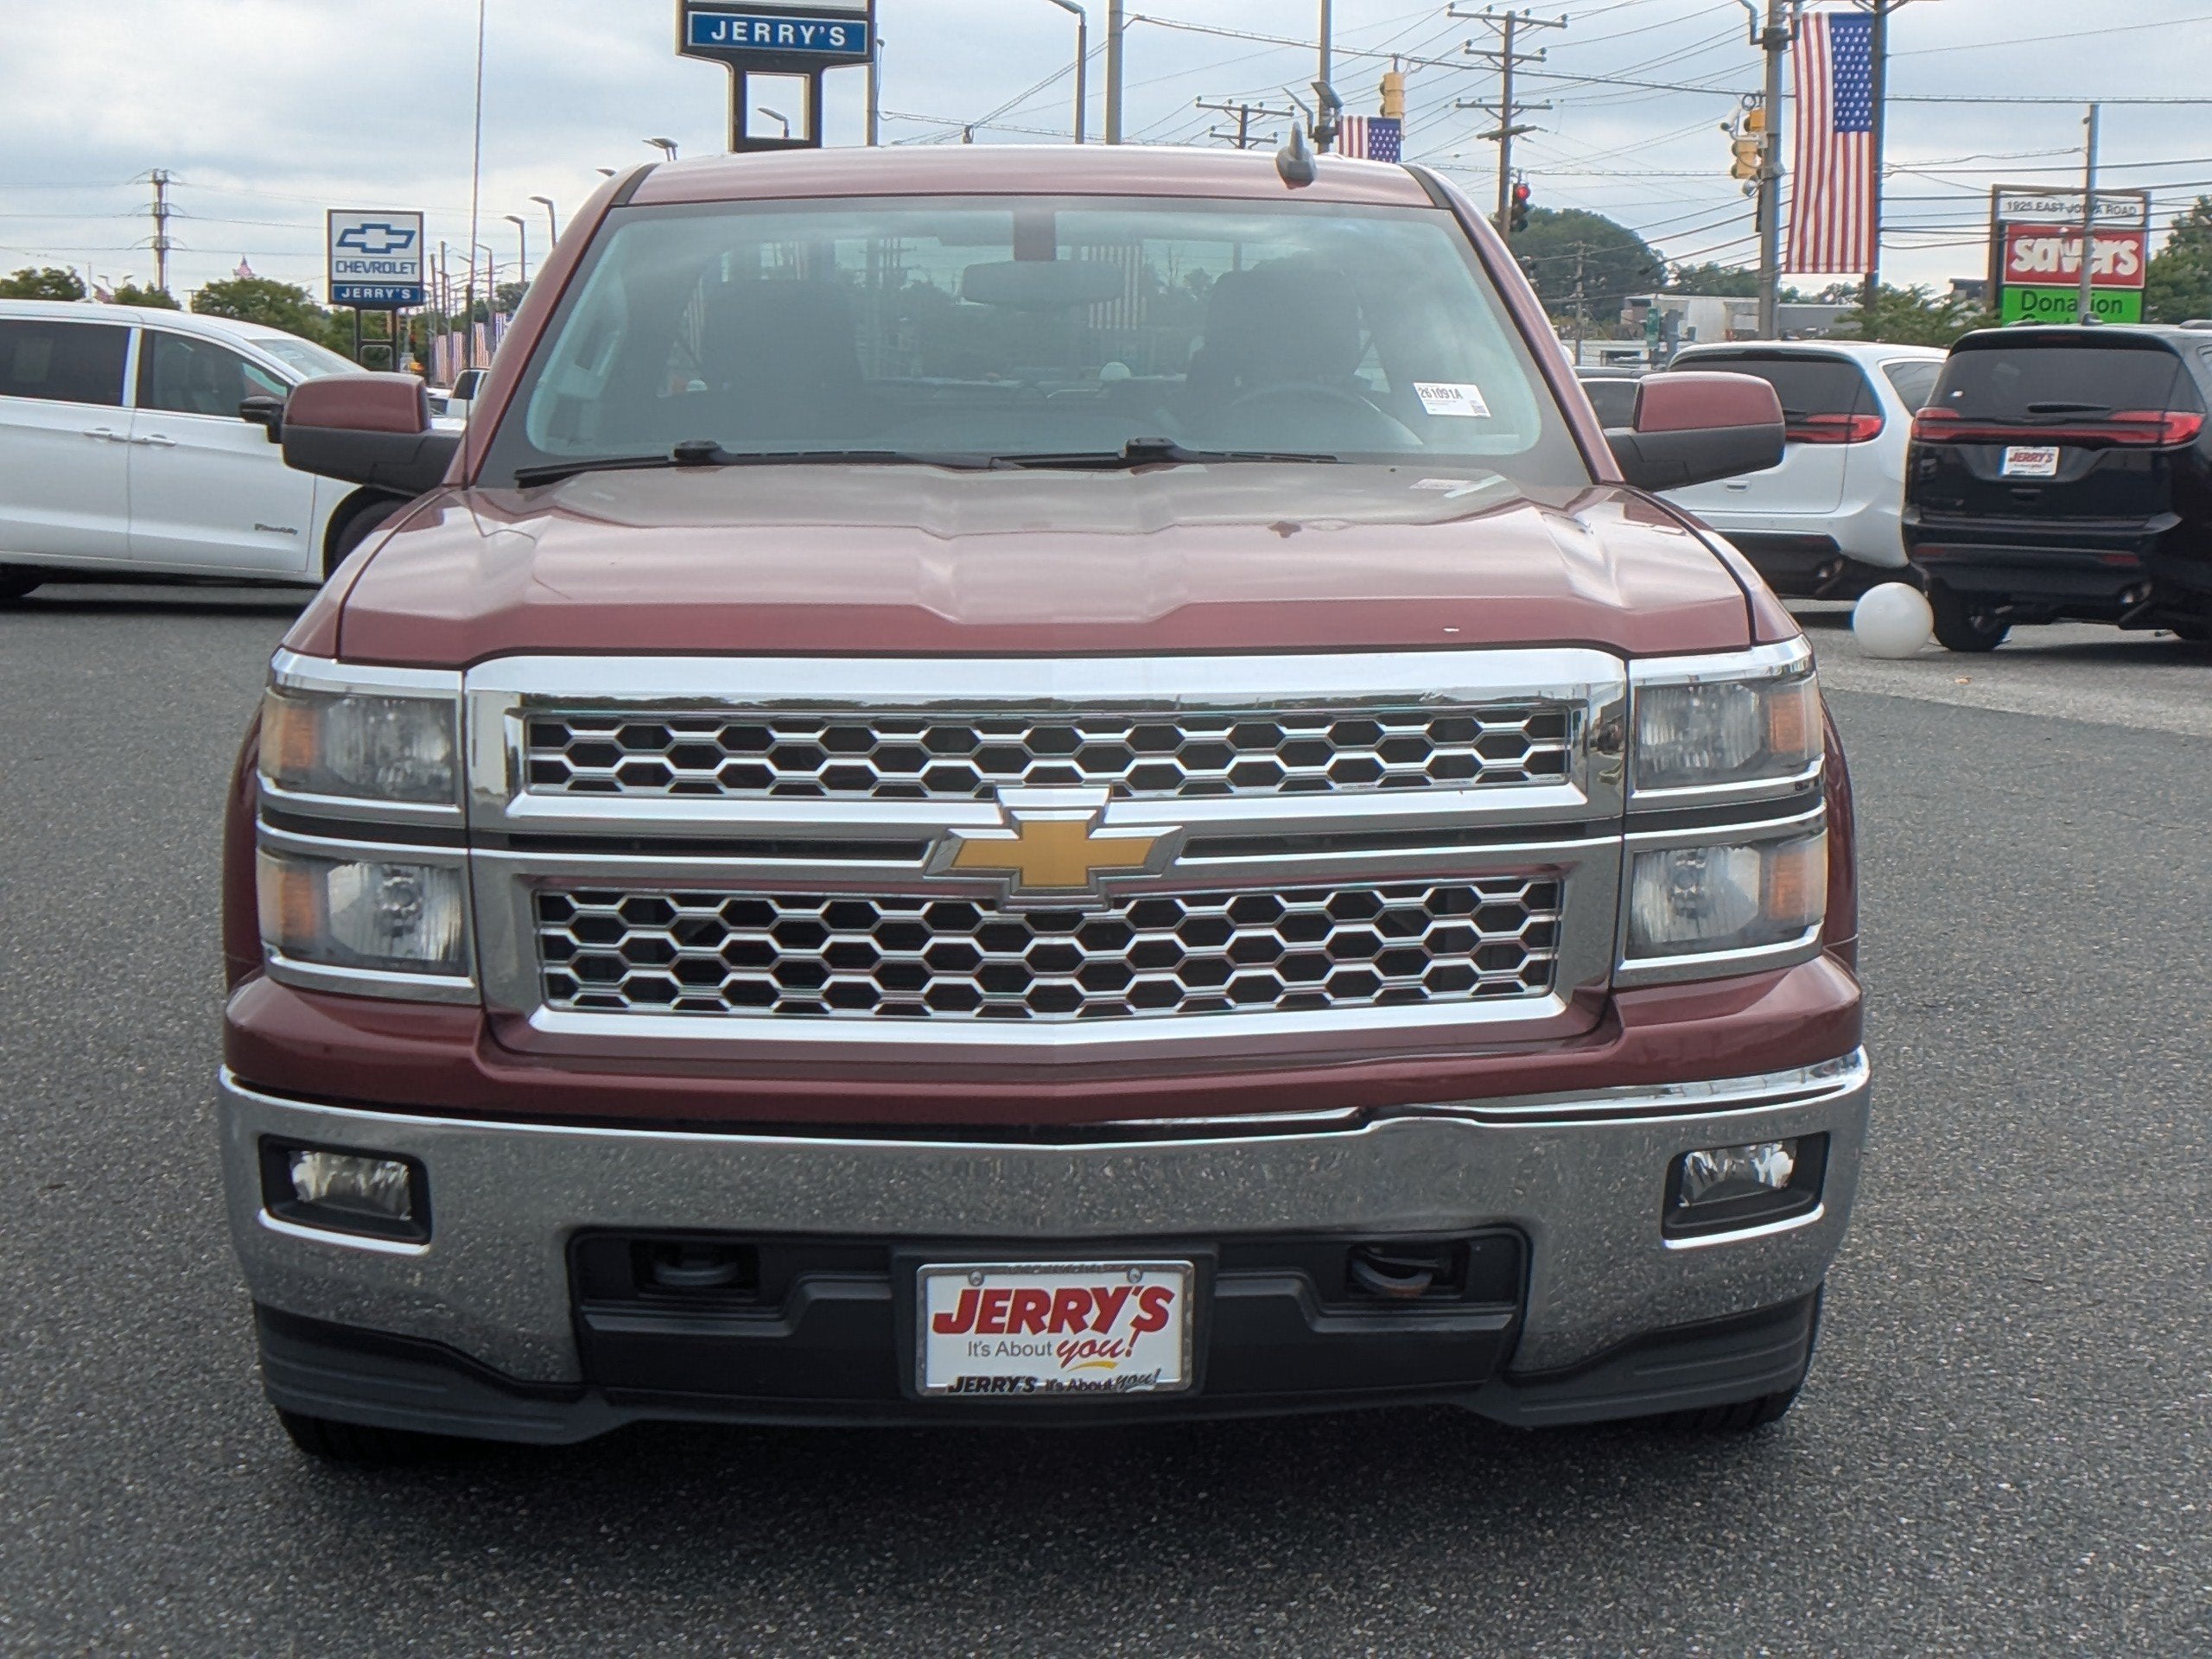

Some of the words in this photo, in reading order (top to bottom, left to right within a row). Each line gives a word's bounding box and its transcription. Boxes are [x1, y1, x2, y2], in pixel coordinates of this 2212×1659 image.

[711, 20, 846, 47] JERRY'S
[2036, 201, 2065, 213] EAST
[2066, 202, 2103, 214] JOA
[2106, 203, 2138, 215] ROAD
[335, 260, 416, 275] CHEVROLET
[341, 287, 411, 300] JERRY'S
[2020, 290, 2124, 314] Donaion
[931, 1285, 1176, 1335] JERRY'S
[968, 1340, 991, 1357] It's
[995, 1340, 1053, 1357] About
[1056, 1329, 1141, 1370] you!
[947, 1375, 1038, 1394] JERRY'S
